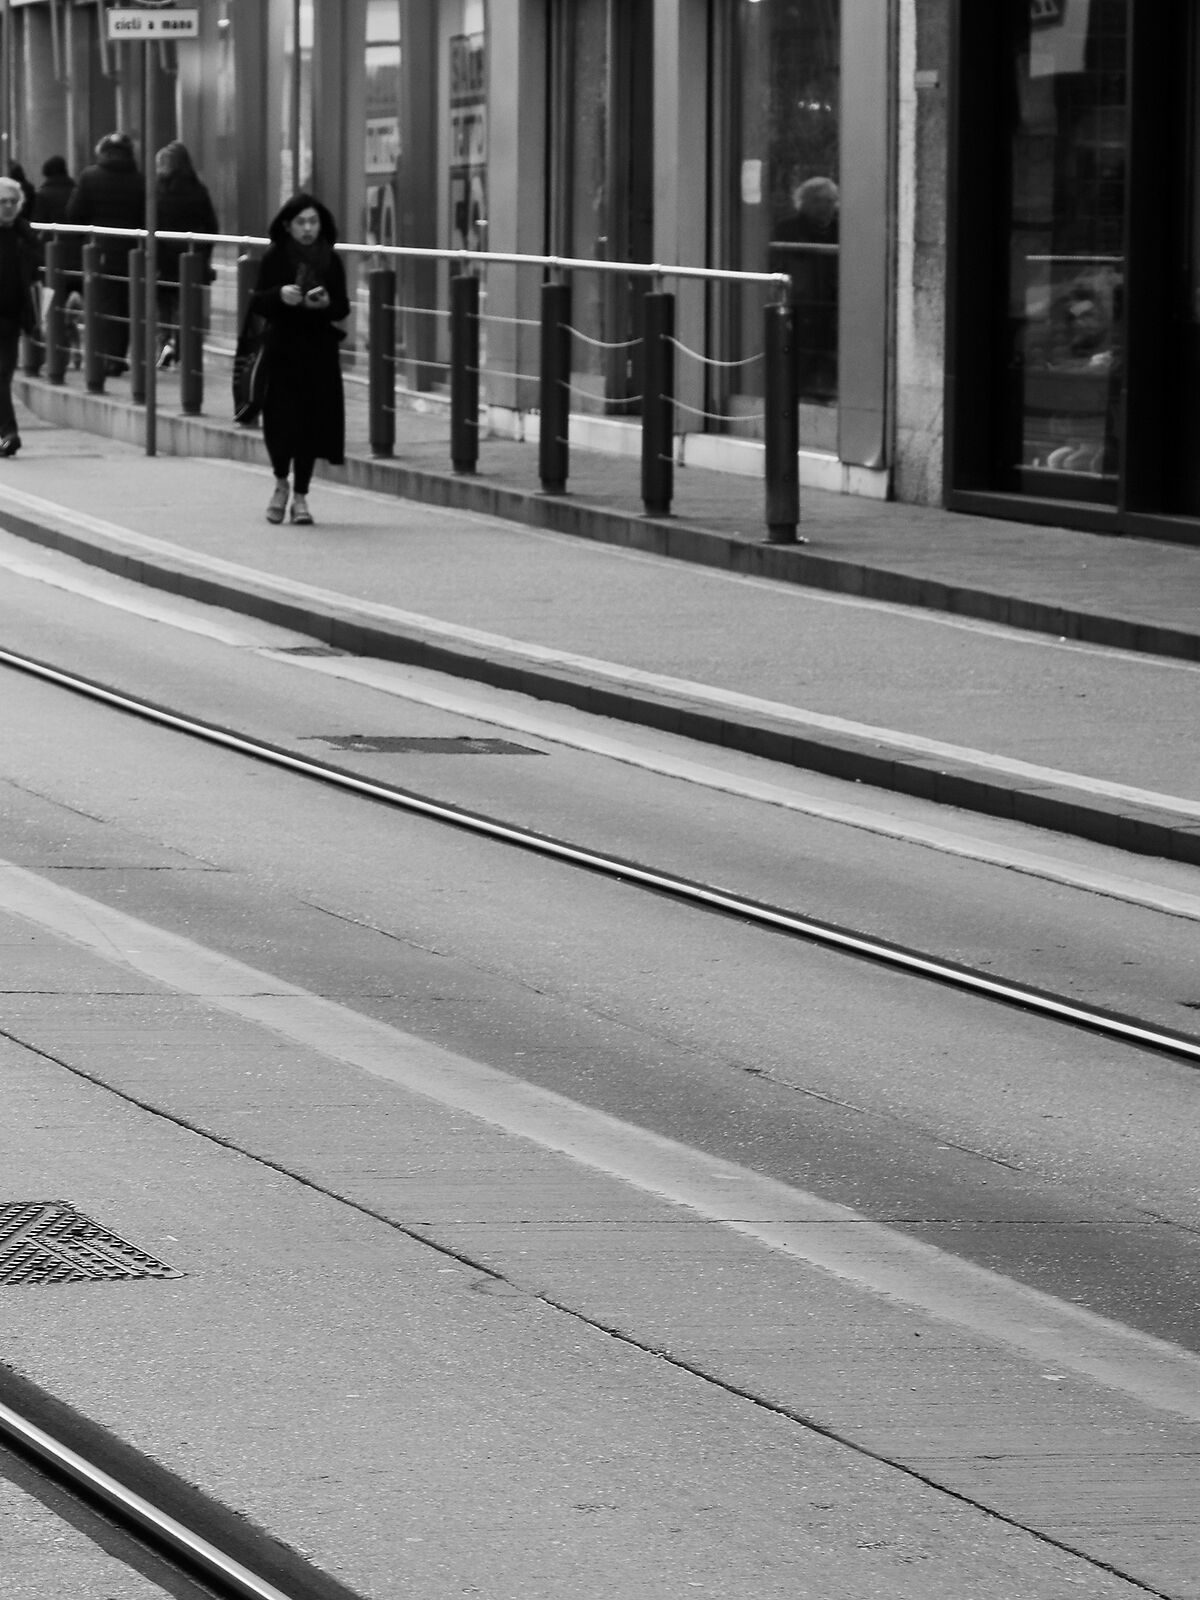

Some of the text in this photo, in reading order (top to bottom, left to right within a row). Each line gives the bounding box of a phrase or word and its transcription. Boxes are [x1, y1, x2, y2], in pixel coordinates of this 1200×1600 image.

[115, 17, 192, 30] cicli a mano
